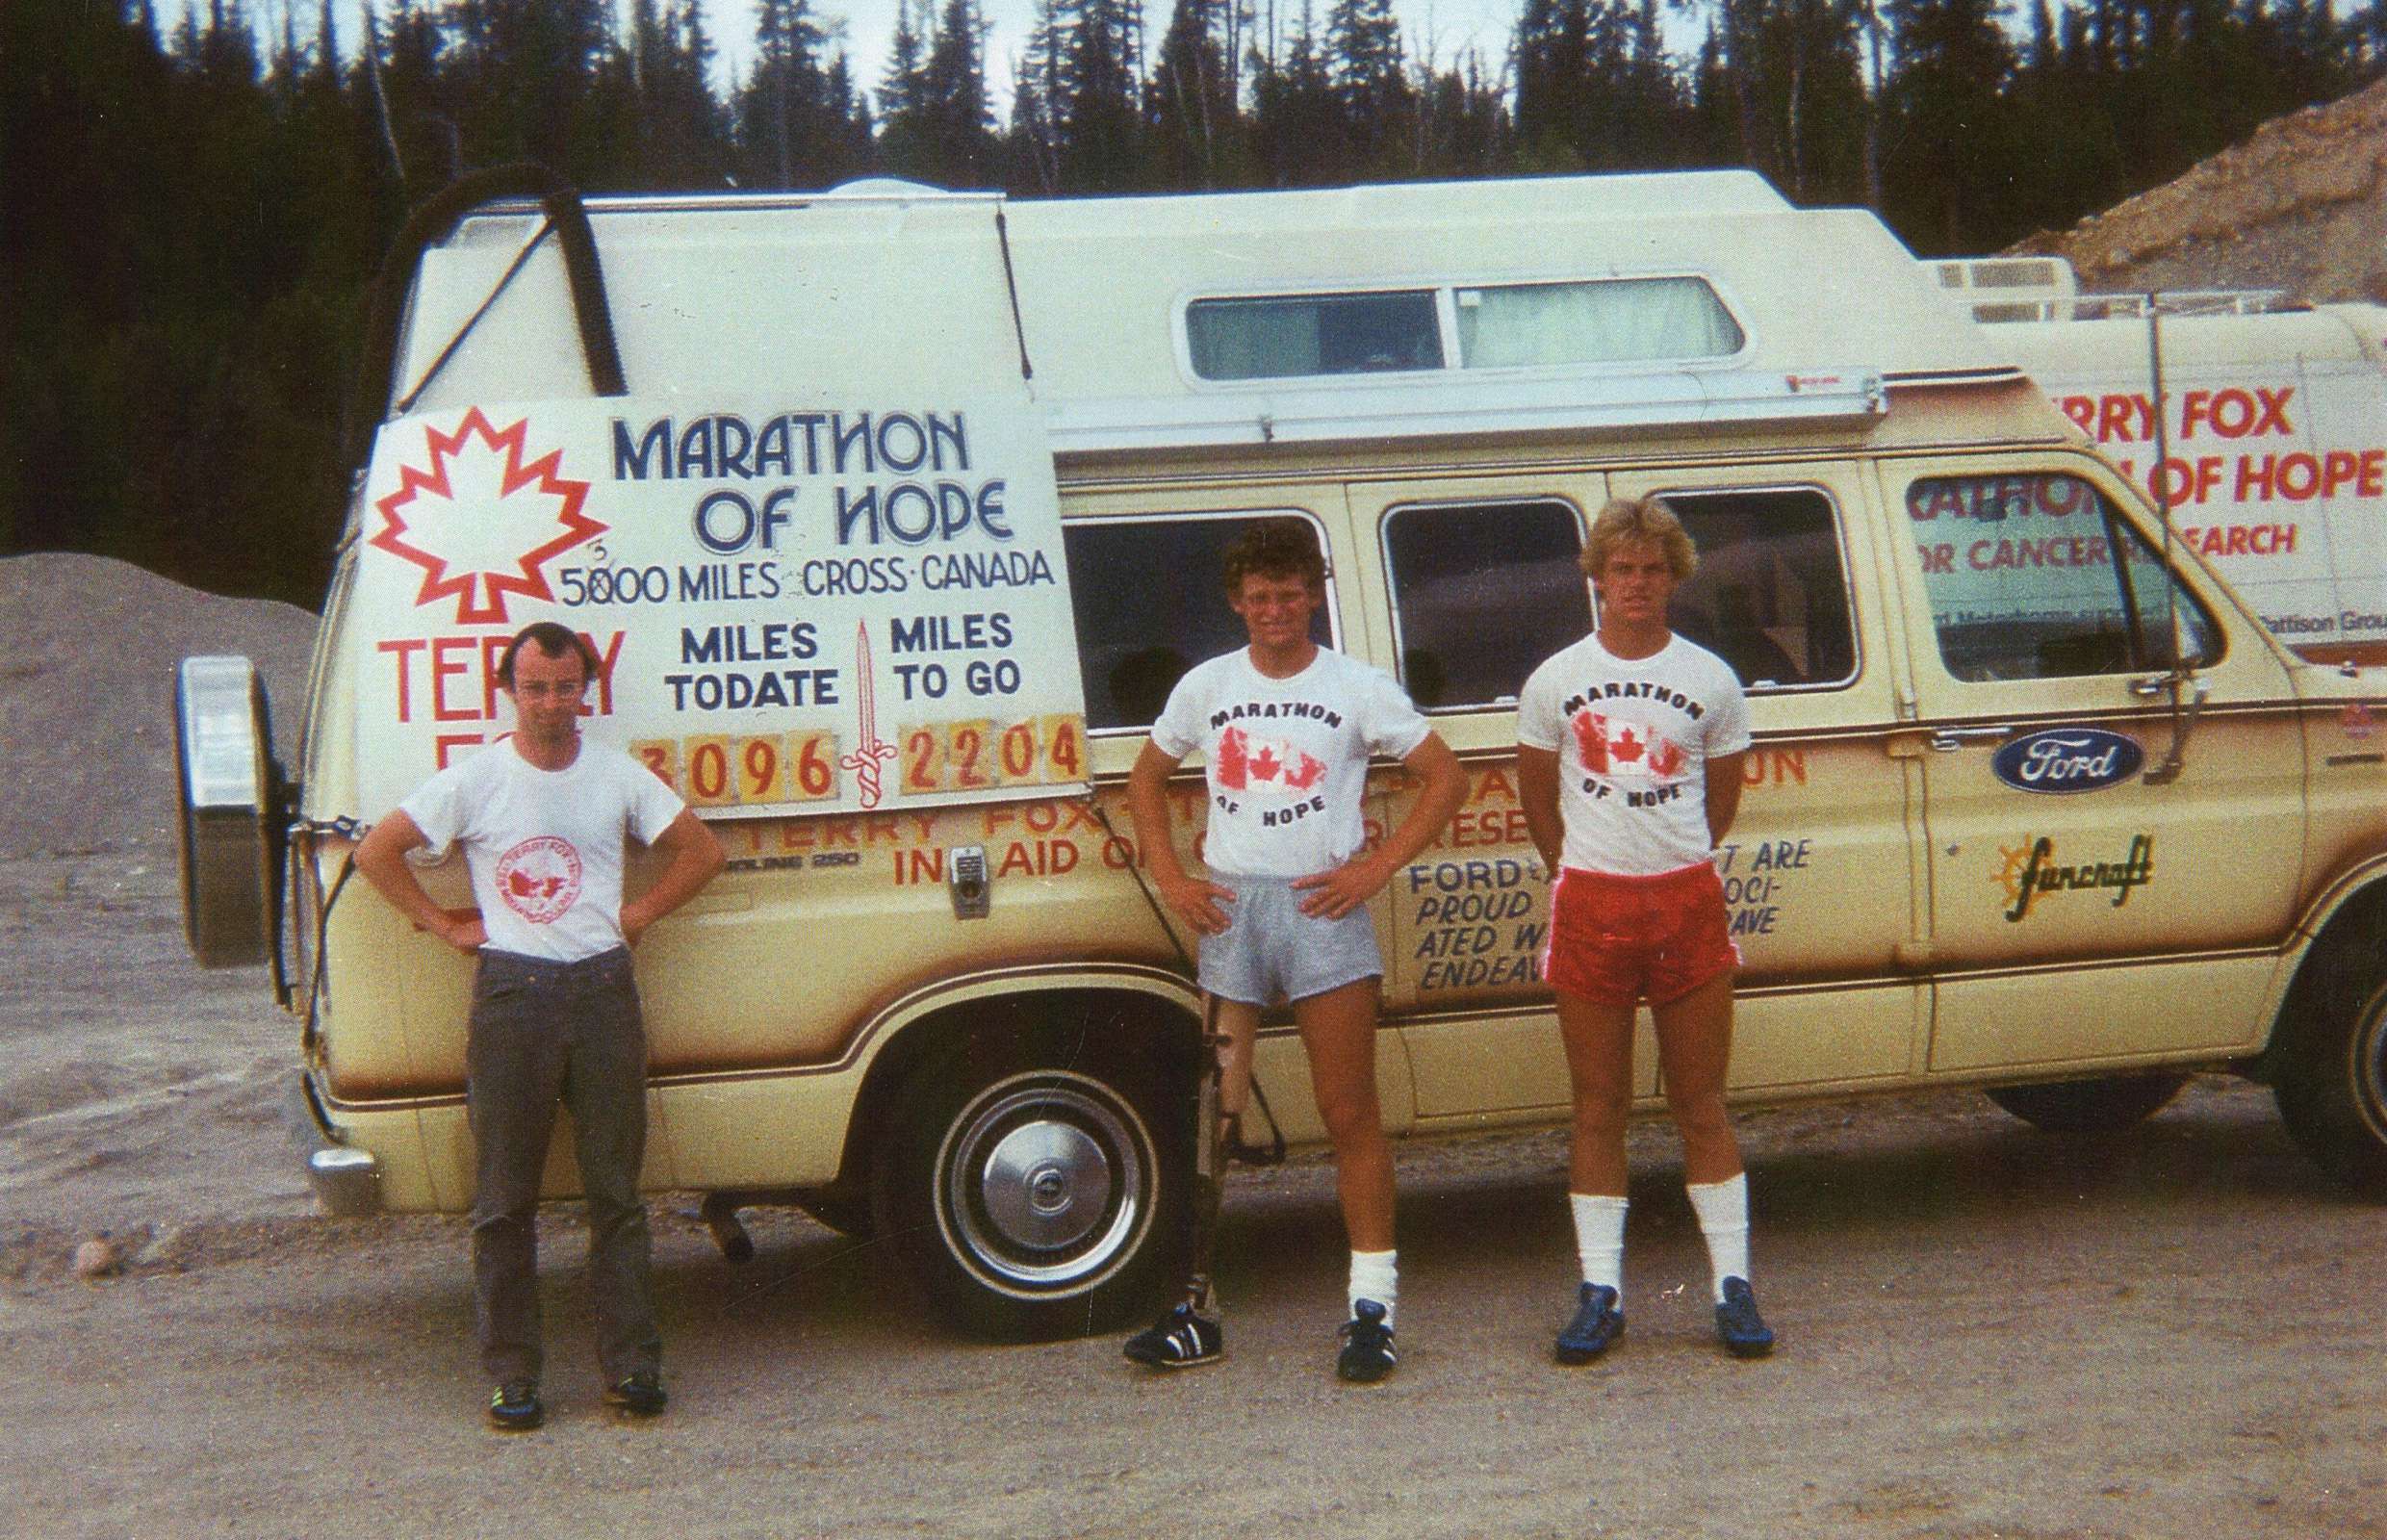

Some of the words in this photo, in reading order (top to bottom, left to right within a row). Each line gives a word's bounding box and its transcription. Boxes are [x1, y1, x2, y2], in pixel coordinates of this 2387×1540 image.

[2059, 392, 2168, 443] RRY
[2180, 387, 2296, 440] FOX
[611, 412, 970, 479] MARATHON
[2147, 456, 2223, 508] OF
[2233, 449, 2385, 502] HOPE
[694, 485, 798, 554] OF
[834, 480, 1014, 546] HOPE
[1966, 535, 2109, 571] CANCER
[678, 559, 782, 603] MILES
[680, 623, 818, 664] MILES
[890, 612, 1014, 654] MILES
[893, 664, 948, 701] TO
[965, 659, 1021, 695] GO
[1564, 681, 1706, 720] MARATHON
[1209, 703, 1343, 730] MARATHON
[908, 722, 1079, 788] 2204
[2020, 738, 2118, 782] Ford
[1263, 795, 1326, 827] HOPE
[1581, 778, 1612, 800] OF
[1628, 784, 1681, 808] HOPE
[738, 811, 941, 855] TERRY
[893, 848, 943, 886] IN
[998, 838, 1080, 878] AID
[1751, 838, 1812, 871] ARE
[1410, 860, 1521, 894] FORD
[1416, 890, 1532, 926] PROUD
[1415, 925, 1498, 960] ATED
